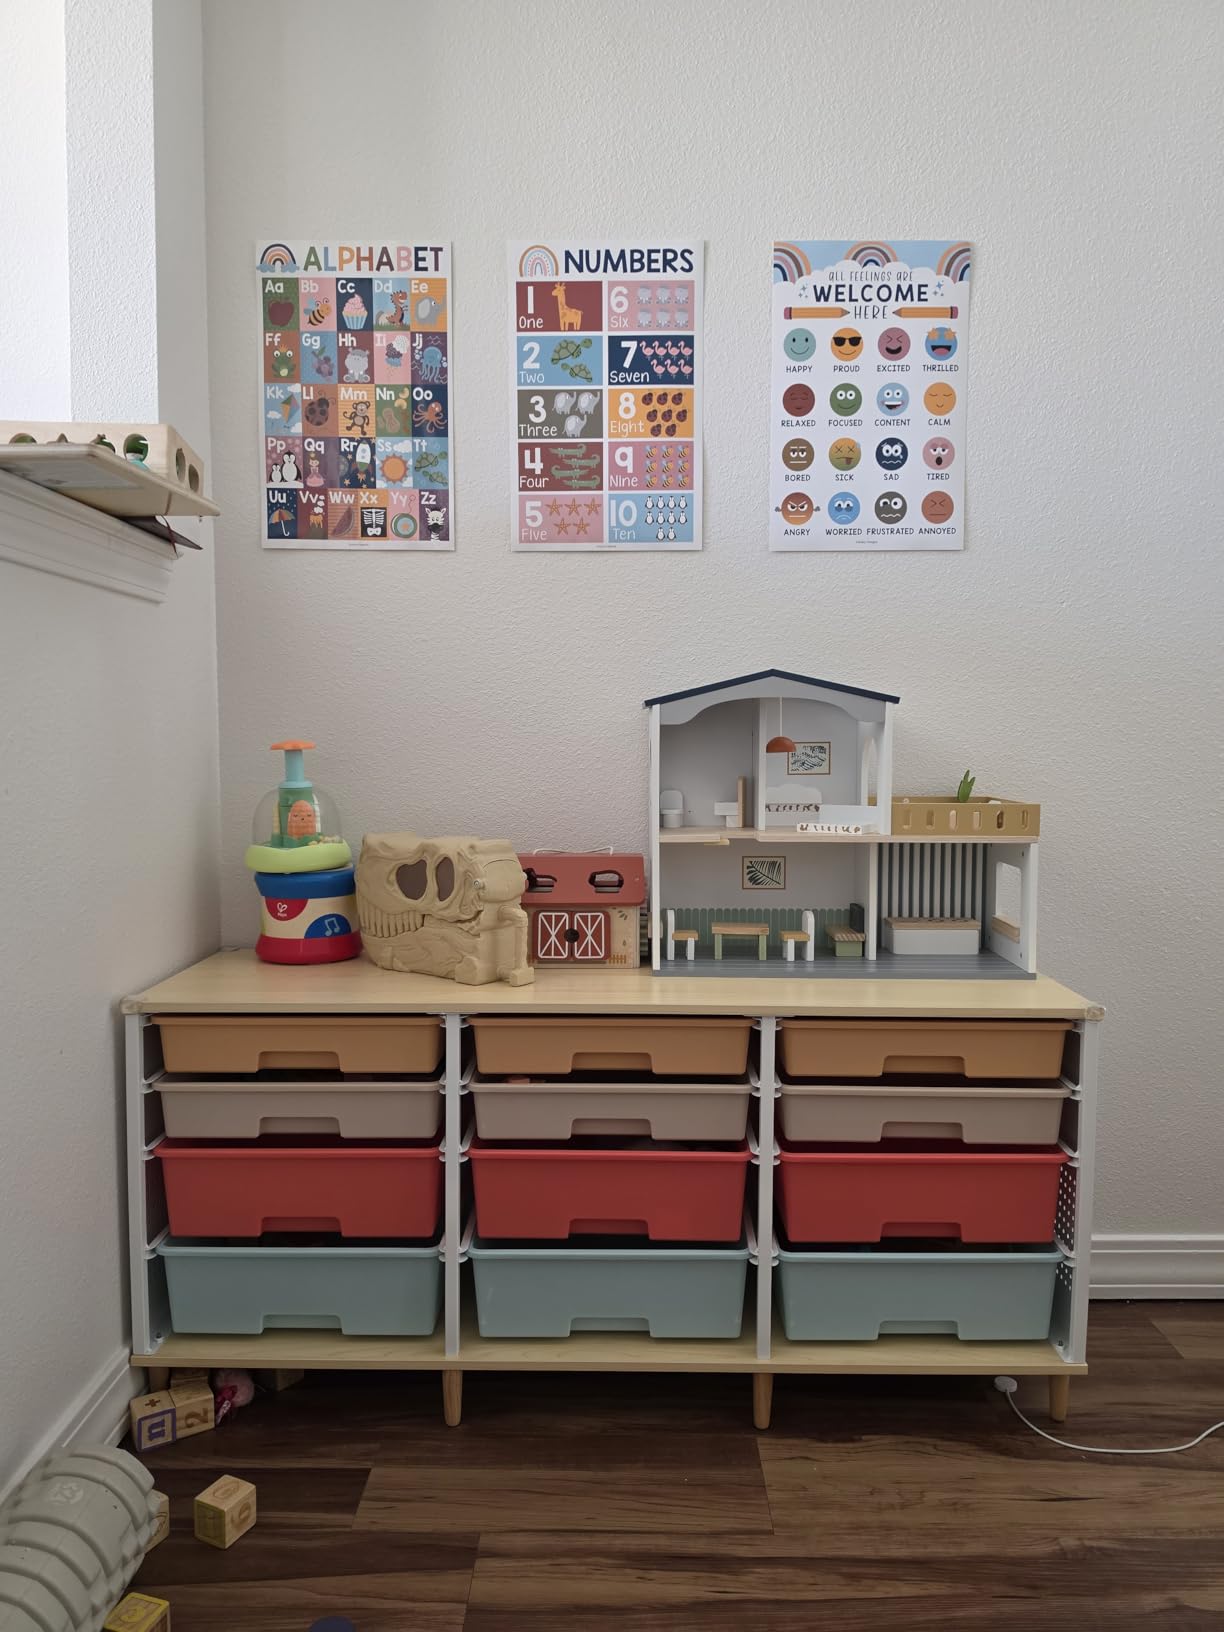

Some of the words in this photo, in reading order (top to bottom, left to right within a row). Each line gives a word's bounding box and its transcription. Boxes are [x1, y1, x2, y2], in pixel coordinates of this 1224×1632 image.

[303, 246, 443, 272] ALPHABET
[565, 249, 694, 273] NUMBERS
[850, 271, 892, 282] FEELINGS
[265, 280, 284, 293] Aa
[301, 280, 319, 293] Bb
[338, 280, 355, 293] Cc
[374, 280, 392, 293] Dd
[411, 280, 428, 292] Ee
[610, 286, 629, 313] 6
[813, 284, 928, 302] WELCOME
[528, 286, 534, 314] 1
[854, 306, 888, 319] HERE
[519, 316, 543, 328] One
[265, 334, 281, 346] Ff
[302, 334, 320, 349] Gg
[338, 334, 356, 346] Hh
[412, 334, 423, 349] Jj
[523, 342, 541, 369] 2
[621, 341, 637, 368] 7
[519, 371, 544, 383] Two
[610, 371, 649, 383] Seven
[266, 386, 284, 399] Kk
[341, 387, 367, 400] Mm
[376, 388, 394, 400] Nn
[413, 388, 432, 400] Oo
[528, 396, 546, 423] 3
[619, 392, 636, 419] 8
[519, 424, 557, 436] Three
[610, 421, 644, 437] Eight
[268, 438, 286, 452] Pp
[304, 438, 324, 454] Qq
[341, 439, 357, 451] Rr
[377, 440, 392, 452] Ss
[414, 439, 427, 451] Tt
[524, 448, 543, 474] 4
[615, 446, 634, 473] 9
[520, 476, 549, 488] Four
[610, 475, 638, 487] Nine
[269, 491, 286, 503] Uu
[300, 491, 318, 503] Vv
[329, 492, 354, 504] Ww
[360, 492, 377, 504] Xx
[390, 492, 408, 507] Yy
[421, 492, 436, 504] Zz
[525, 501, 543, 527] 5
[610, 500, 637, 527] 10
[522, 529, 547, 540] Five
[613, 528, 636, 540] Ten
